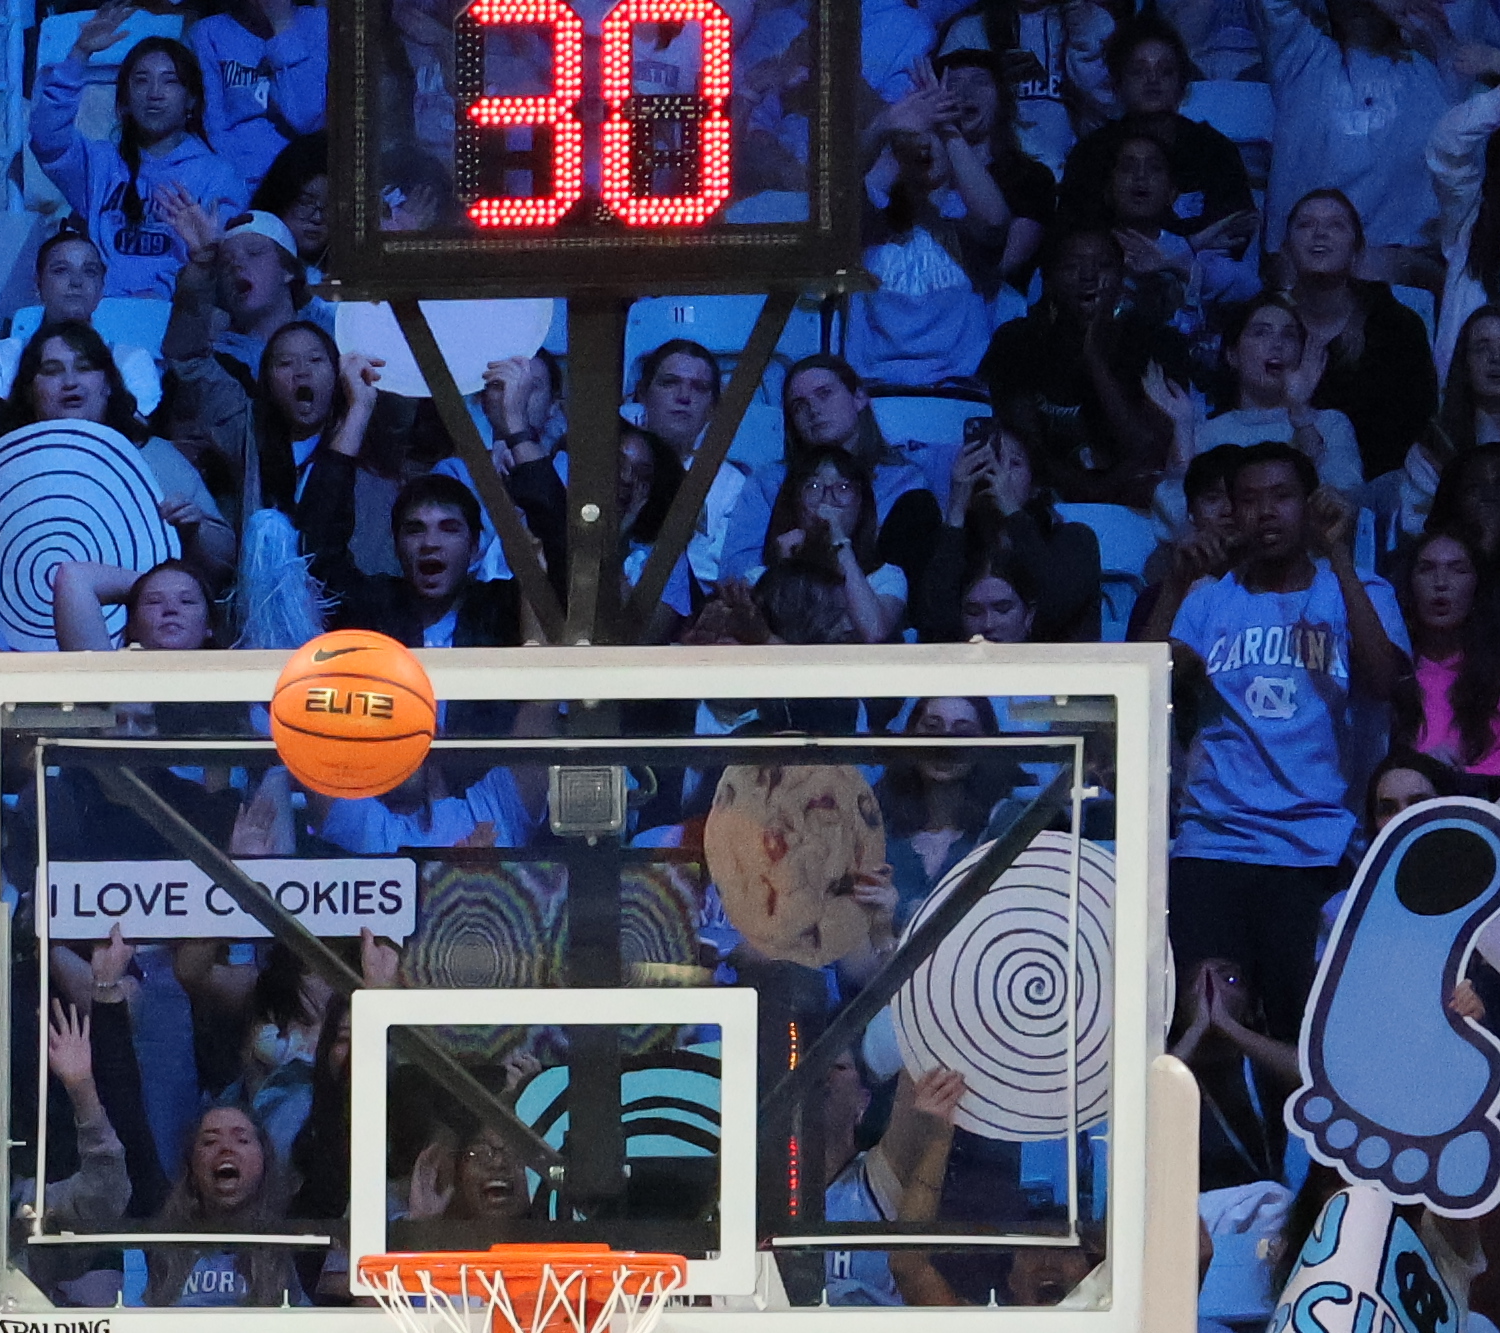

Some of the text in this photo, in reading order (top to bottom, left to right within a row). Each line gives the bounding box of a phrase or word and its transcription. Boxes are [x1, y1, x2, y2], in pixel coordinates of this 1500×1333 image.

[465, 0, 733, 228] 30
[1206, 625, 1349, 679] CAROLINA
[304, 687, 394, 720] ELITE
[50, 883, 58, 917] I
[73, 882, 190, 917] LOVE
